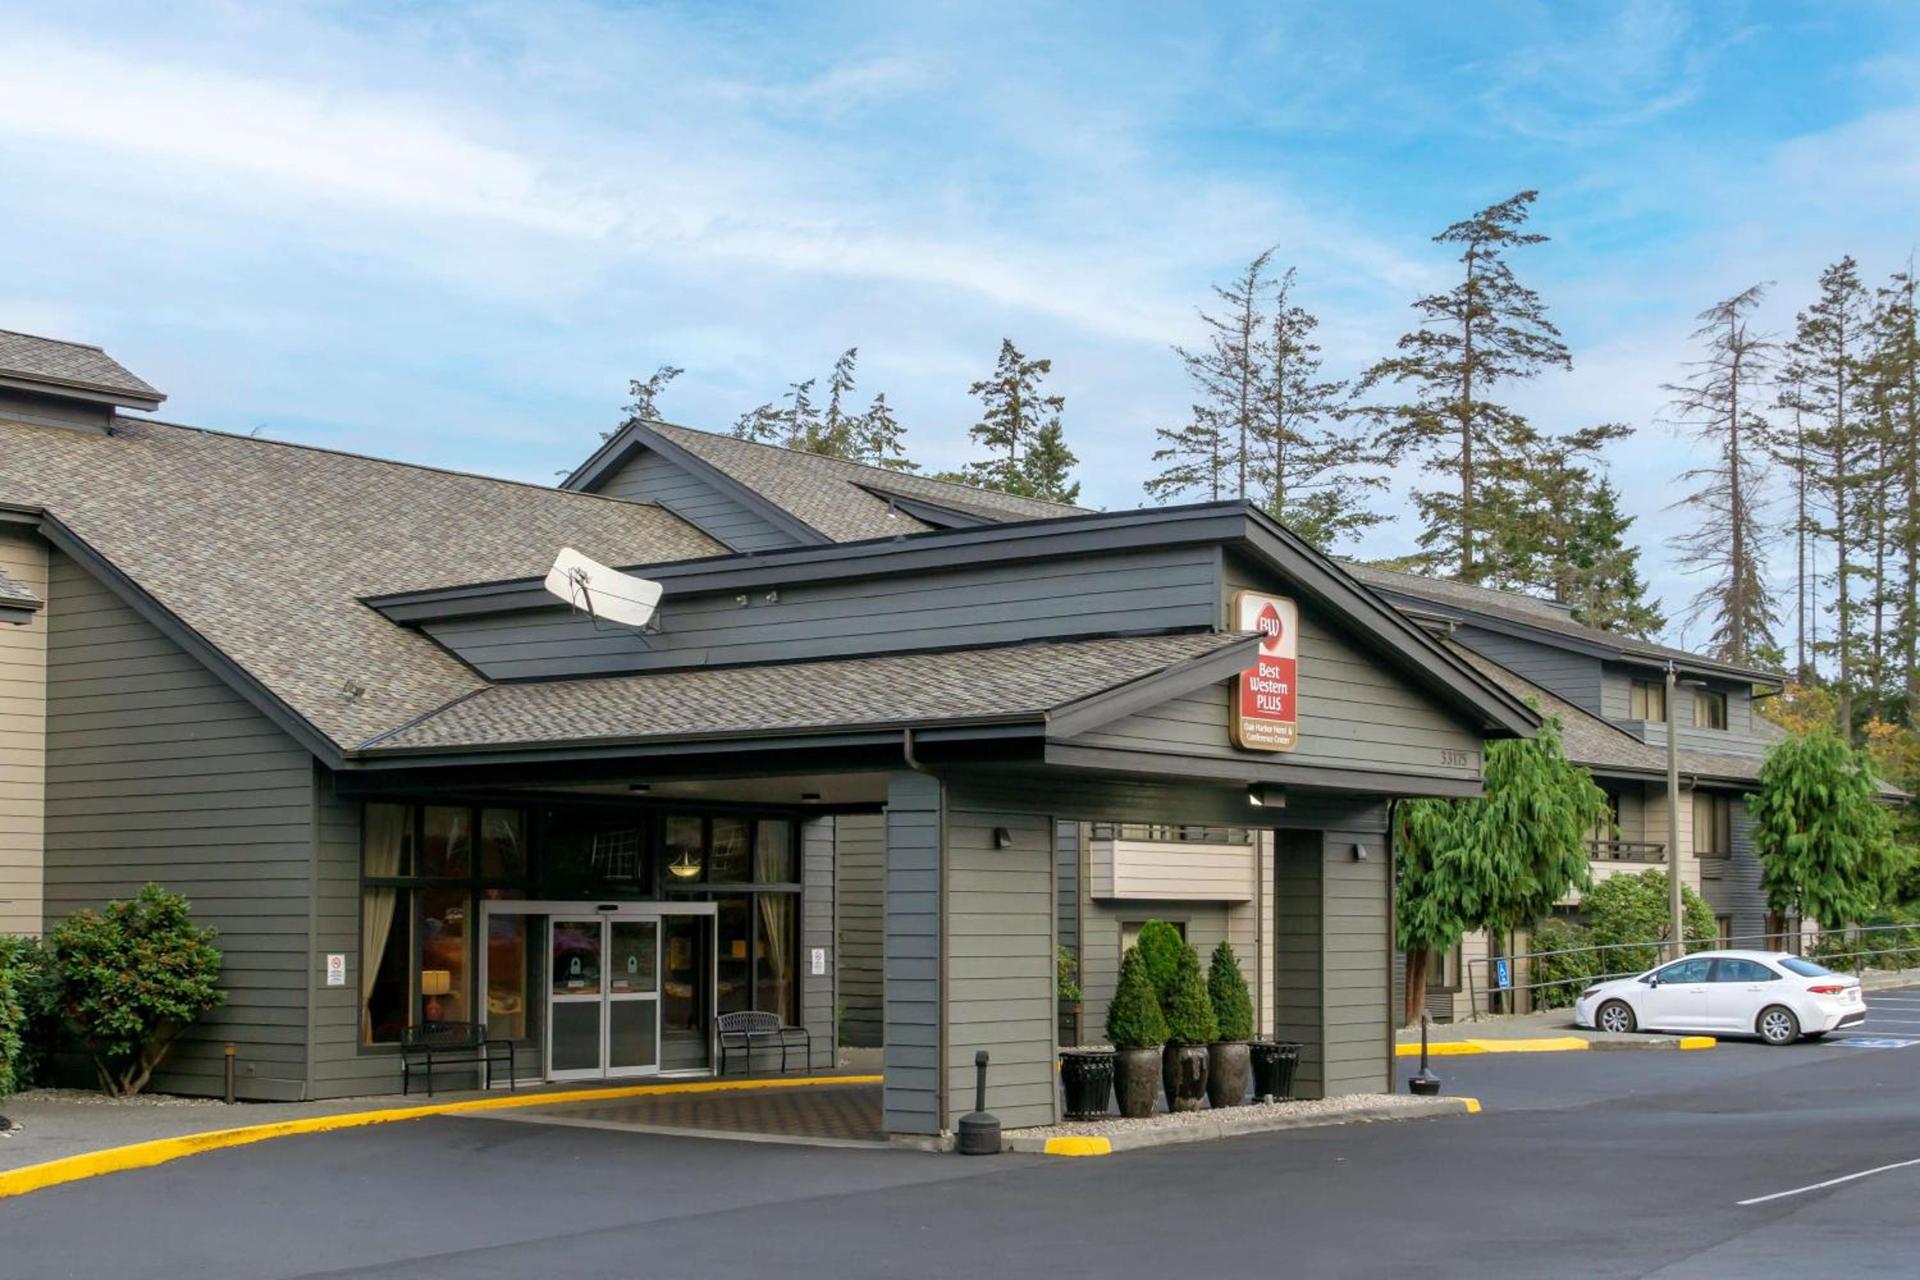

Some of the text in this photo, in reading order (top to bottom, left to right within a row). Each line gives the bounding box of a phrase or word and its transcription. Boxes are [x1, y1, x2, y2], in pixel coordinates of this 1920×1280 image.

[1260, 617, 1280, 637] BW
[1259, 662, 1280, 679] Best
[1249, 676, 1288, 695] Western
[1256, 694, 1281, 711] PLUS
[1256, 723, 1272, 733] Harbor
[1246, 732, 1290, 745] Conference Center
